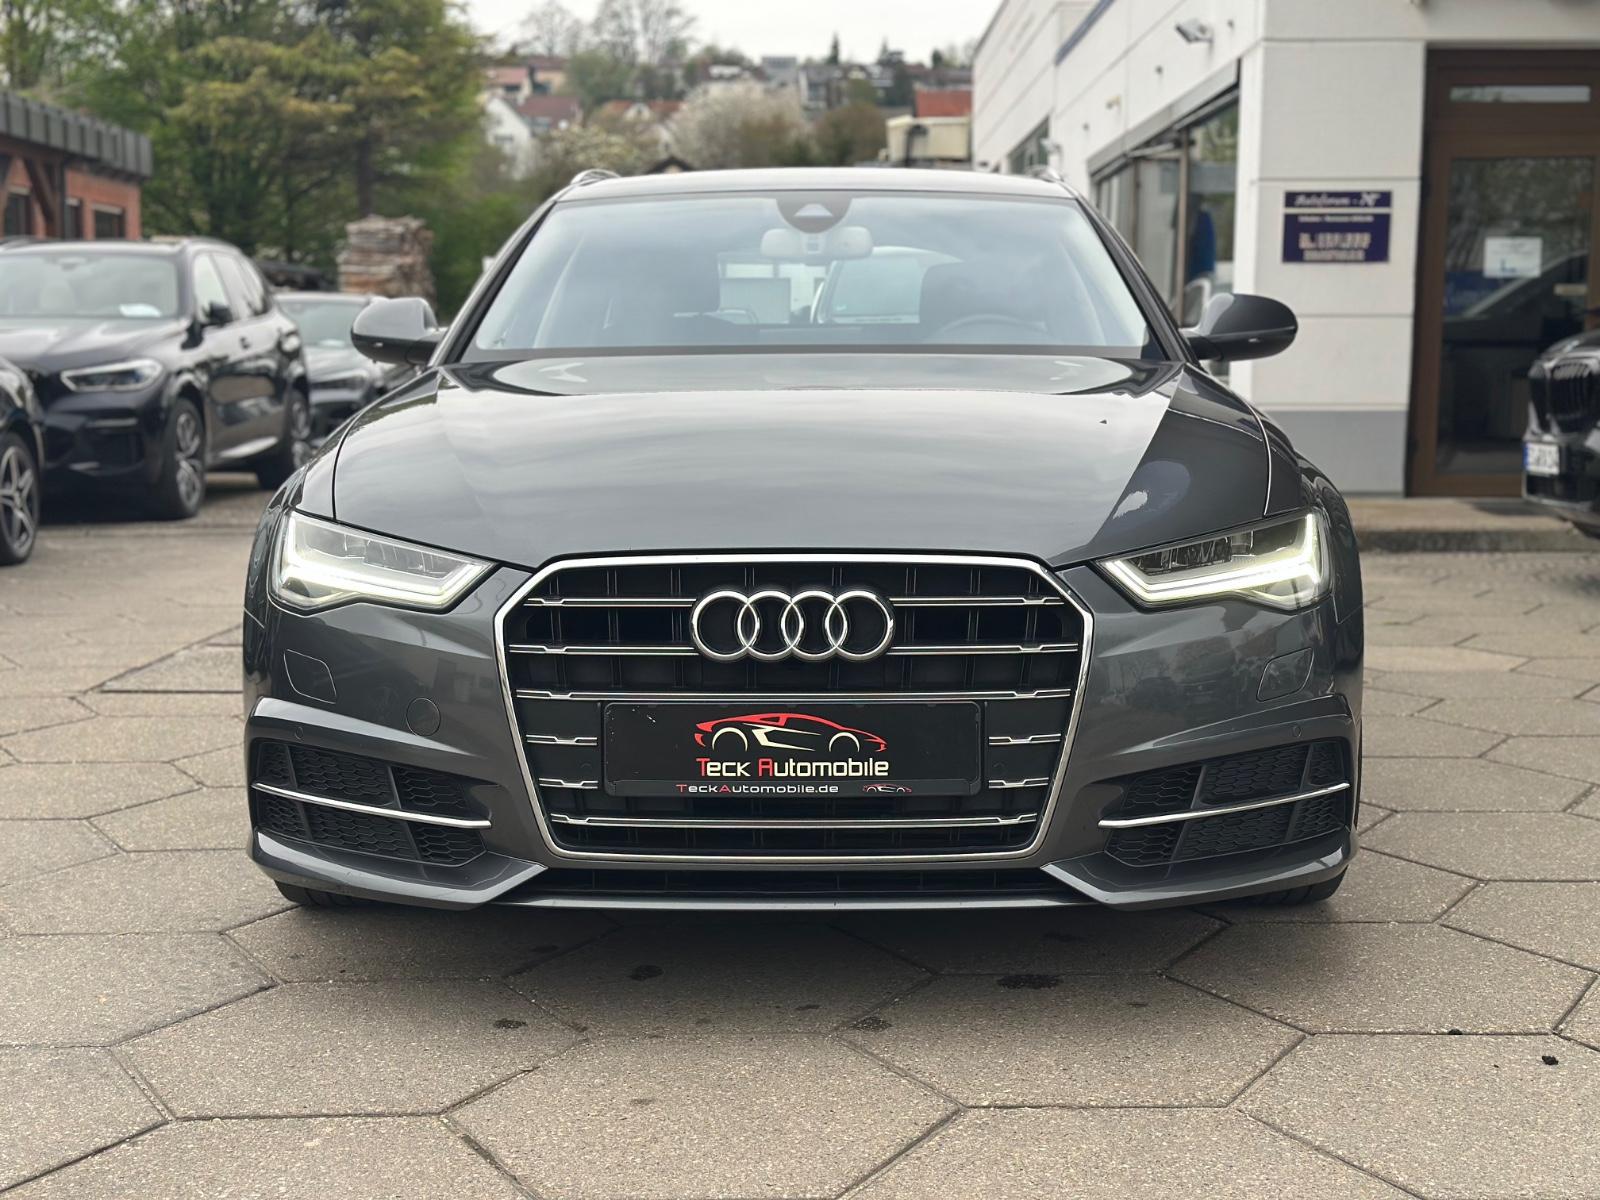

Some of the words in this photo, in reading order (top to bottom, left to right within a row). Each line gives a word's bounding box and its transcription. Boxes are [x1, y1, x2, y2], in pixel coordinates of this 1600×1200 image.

[696, 758, 751, 777] Teck
[759, 758, 889, 777] Automobile
[676, 784, 839, 793] TeckAutomobile.de
